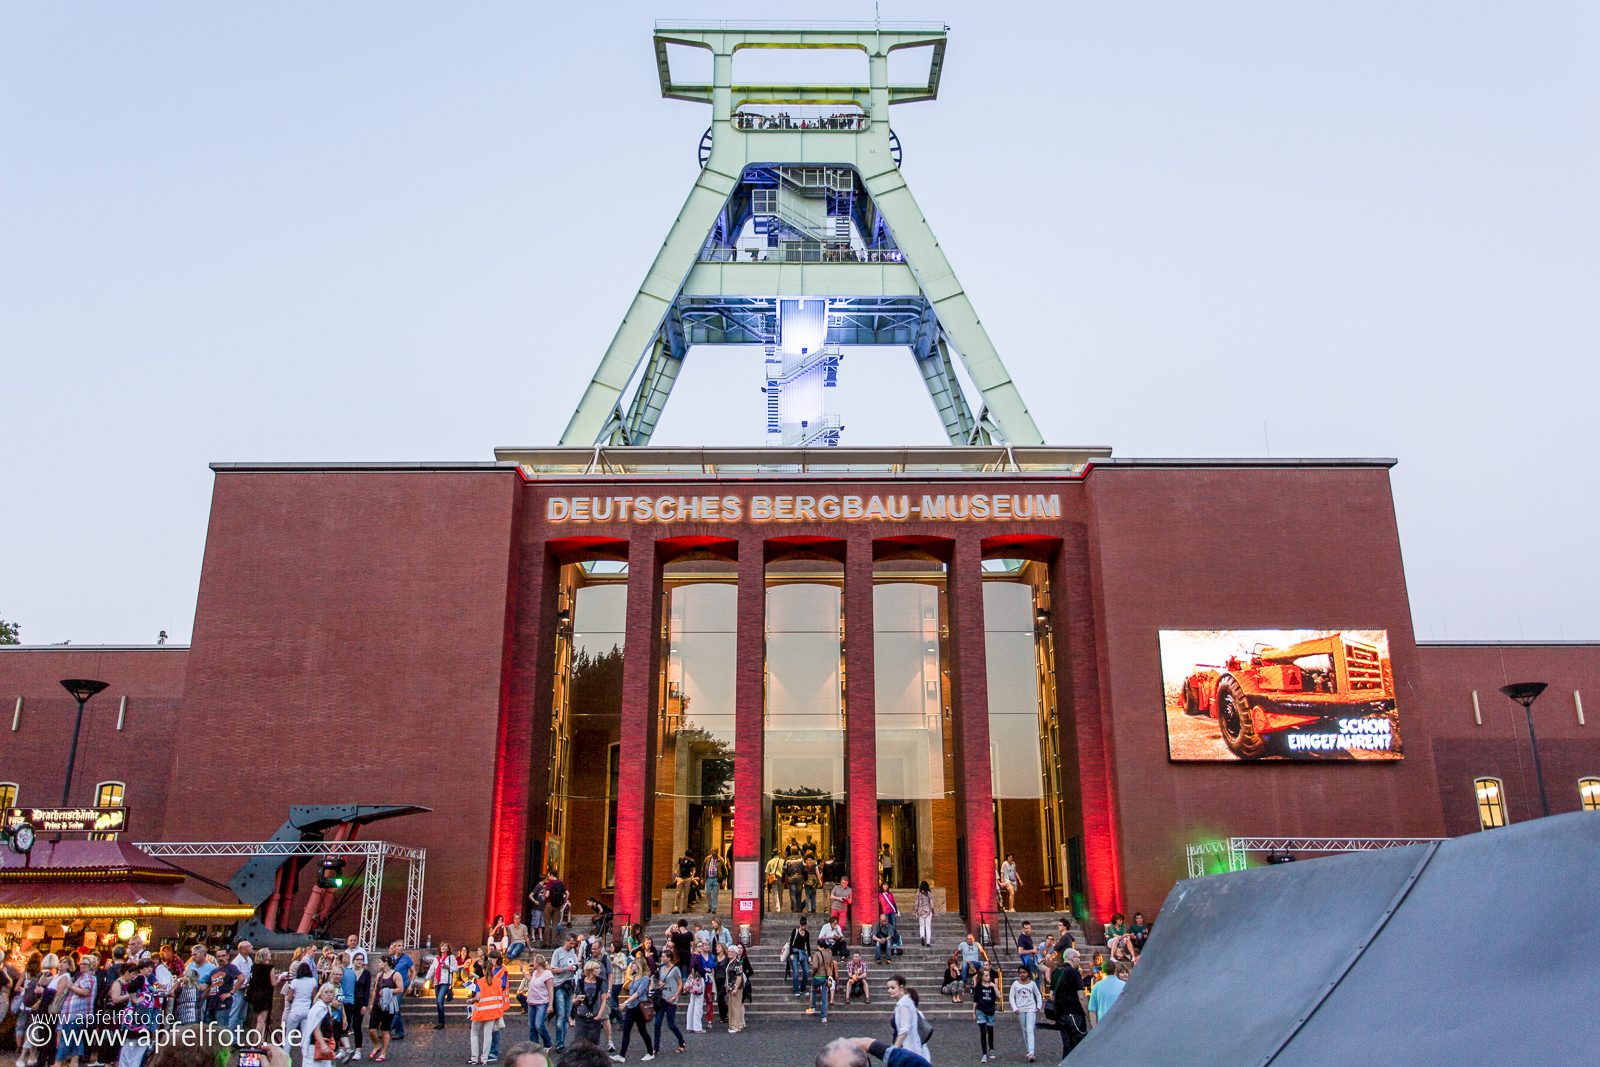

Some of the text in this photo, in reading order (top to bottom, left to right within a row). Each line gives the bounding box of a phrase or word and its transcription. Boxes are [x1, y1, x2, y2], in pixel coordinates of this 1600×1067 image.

[547, 494, 1061, 520] DEUTSCHES BERGBAU-MUSEUM
[1338, 718, 1391, 734] SCHON
[1287, 733, 1392, 750] EINGEFAHREN?
